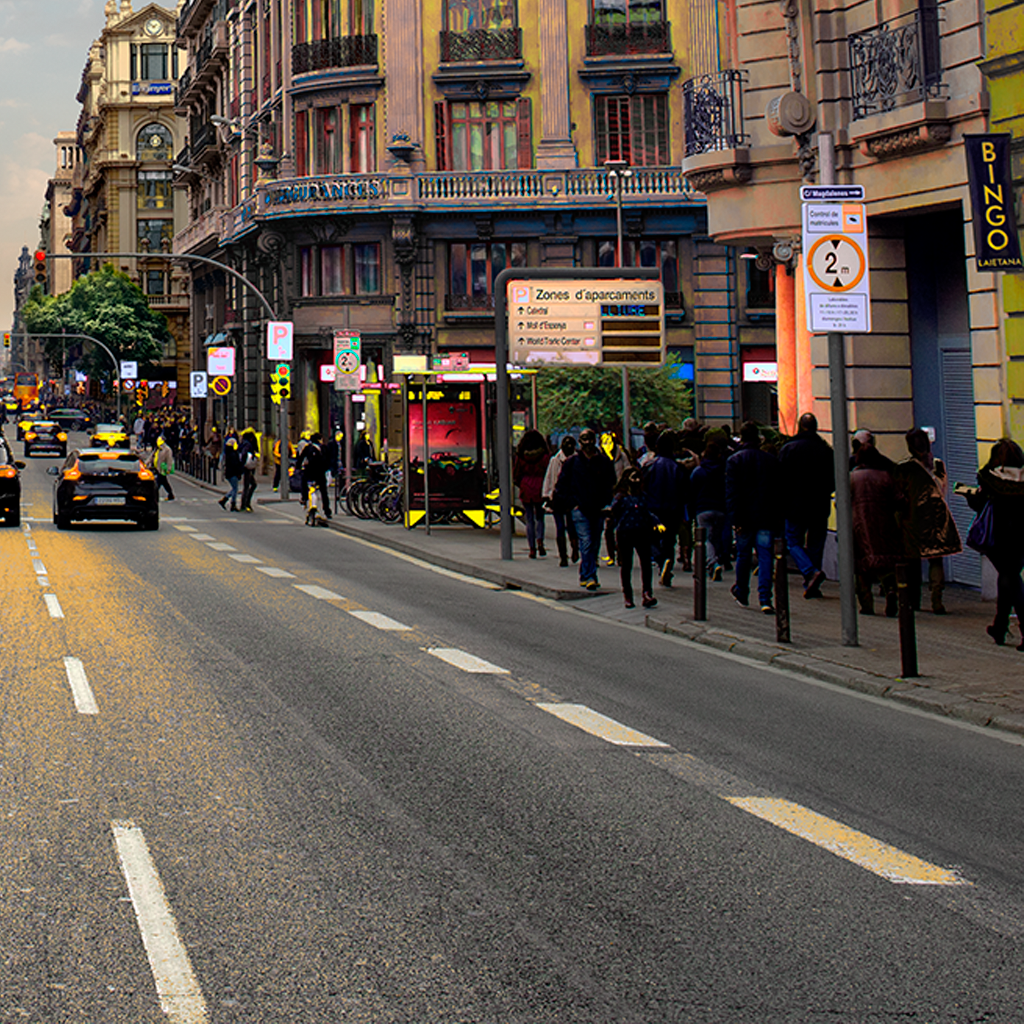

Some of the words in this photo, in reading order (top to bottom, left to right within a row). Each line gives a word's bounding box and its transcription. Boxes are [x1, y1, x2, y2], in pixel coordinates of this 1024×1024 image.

[981, 141, 1009, 250] BINGO
[809, 210, 830, 218] Control
[825, 251, 838, 274] 2
[978, 258, 1022, 267] LAIETANA
[536, 289, 570, 301] Zones
[273, 325, 288, 345] P
[193, 373, 204, 387] P
